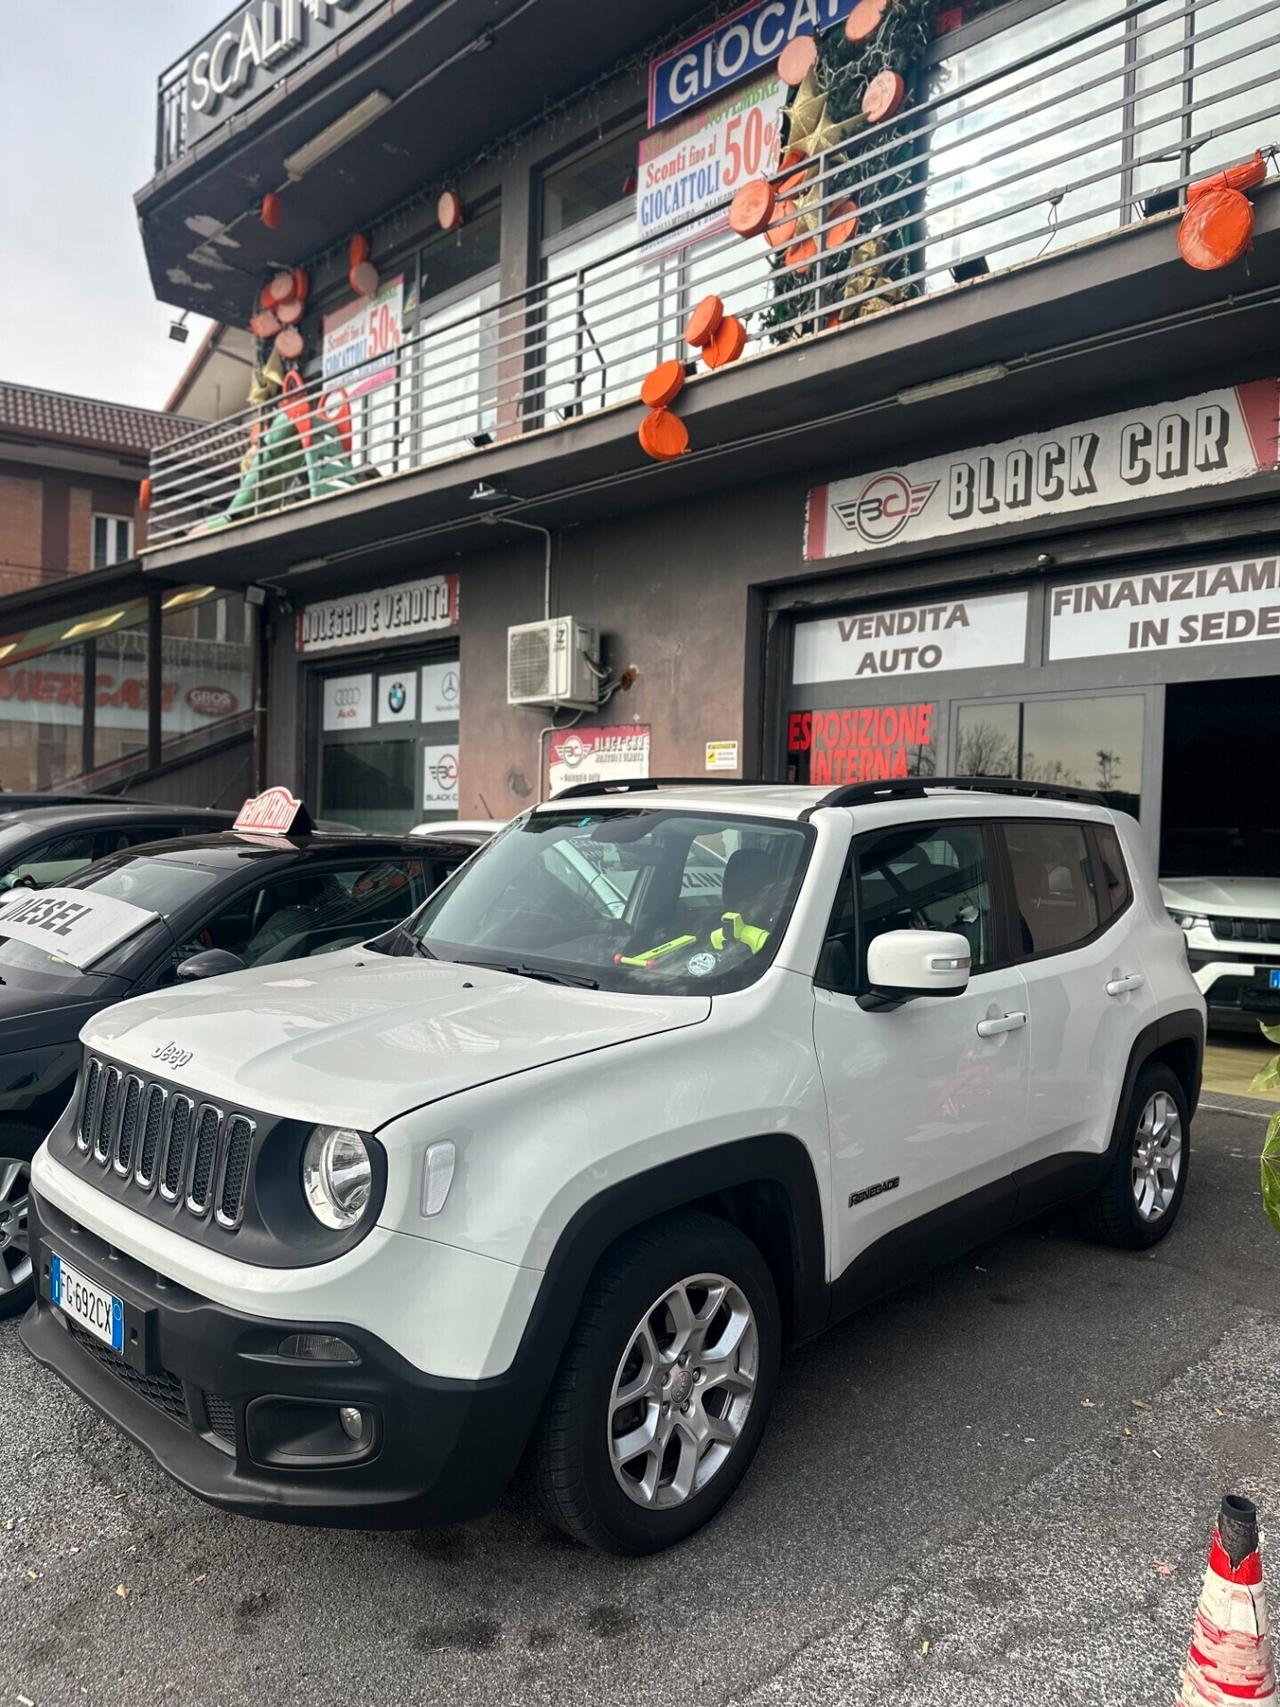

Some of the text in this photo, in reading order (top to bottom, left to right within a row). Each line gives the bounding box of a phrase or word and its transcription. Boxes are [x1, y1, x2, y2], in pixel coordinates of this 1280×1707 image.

[645, 147, 686, 189] Sconti
[689, 144, 706, 167] fino
[722, 106, 781, 187] 50%
[641, 160, 721, 227] GIOCATTOLI
[368, 303, 401, 357] 50%
[948, 433, 1099, 520] BLACK
[1120, 404, 1230, 485] CAR
[1053, 560, 1280, 616] FINANZIAM
[303, 583, 450, 643] NOLEGGIO E VENDITA
[837, 603, 970, 642] VENDITA
[1128, 606, 1280, 649] IN SEDE
[855, 644, 942, 675] AUTO
[191, 690, 231, 704] GROS
[788, 703, 933, 751] ESPOSIZIONE
[810, 747, 909, 785] INTERNA
[0, 898, 93, 937] DIESEL
[151, 1040, 194, 1070] Jeep
[847, 1175, 900, 1208] RENEGADE
